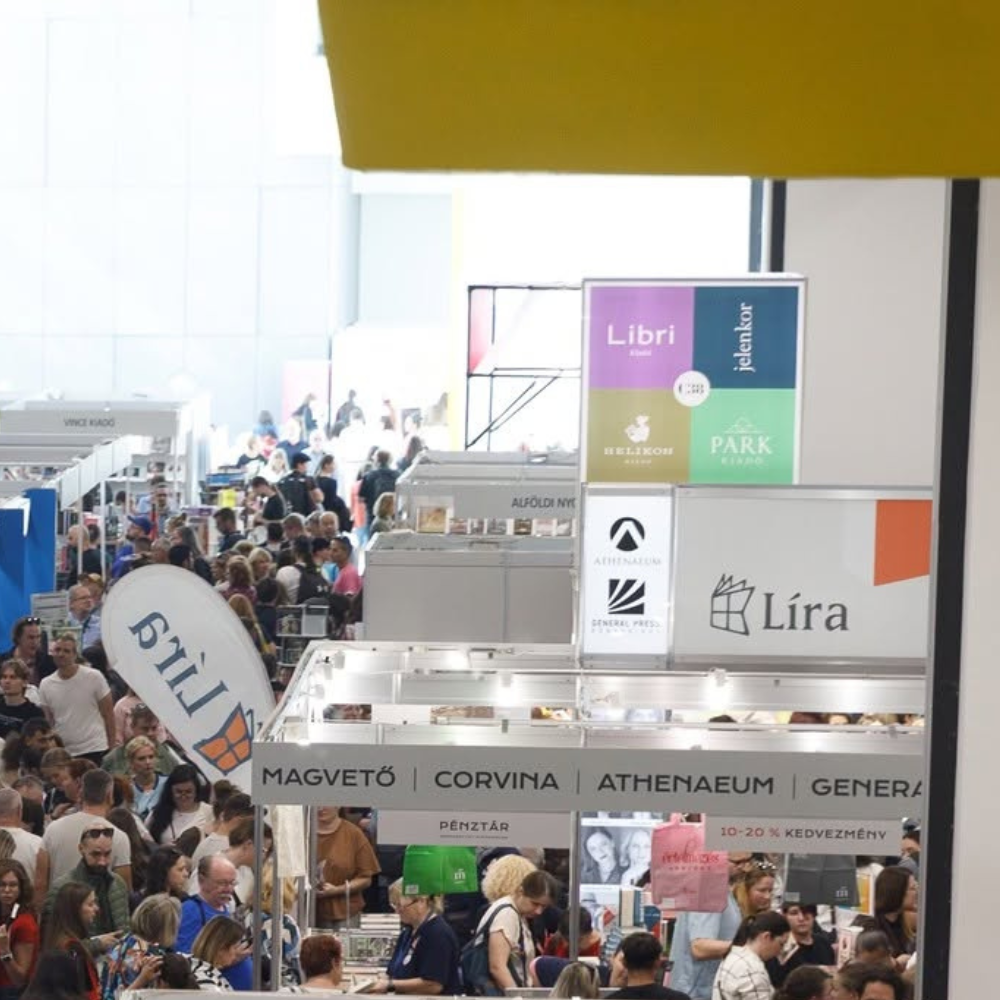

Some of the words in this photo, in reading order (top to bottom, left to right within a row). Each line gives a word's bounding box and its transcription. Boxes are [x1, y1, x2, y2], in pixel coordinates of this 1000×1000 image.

[607, 324, 676, 346] Libri
[733, 302, 756, 372] jelenkor
[63, 418, 87, 428] VINCE
[604, 446, 674, 456] HELIKON
[710, 435, 772, 455] PARK
[511, 495, 554, 508] ALFÖLDI
[762, 592, 850, 632] Líra
[262, 765, 396, 788] MAGVETŐ
[434, 770, 559, 791] CORVINA
[597, 773, 775, 795] ATHENAEUM
[439, 820, 510, 832] PÉNZTÁR
[720, 827, 765, 837] 10-20
[769, 828, 781, 838] %
[784, 826, 887, 841] KEDVEZMÉNY
